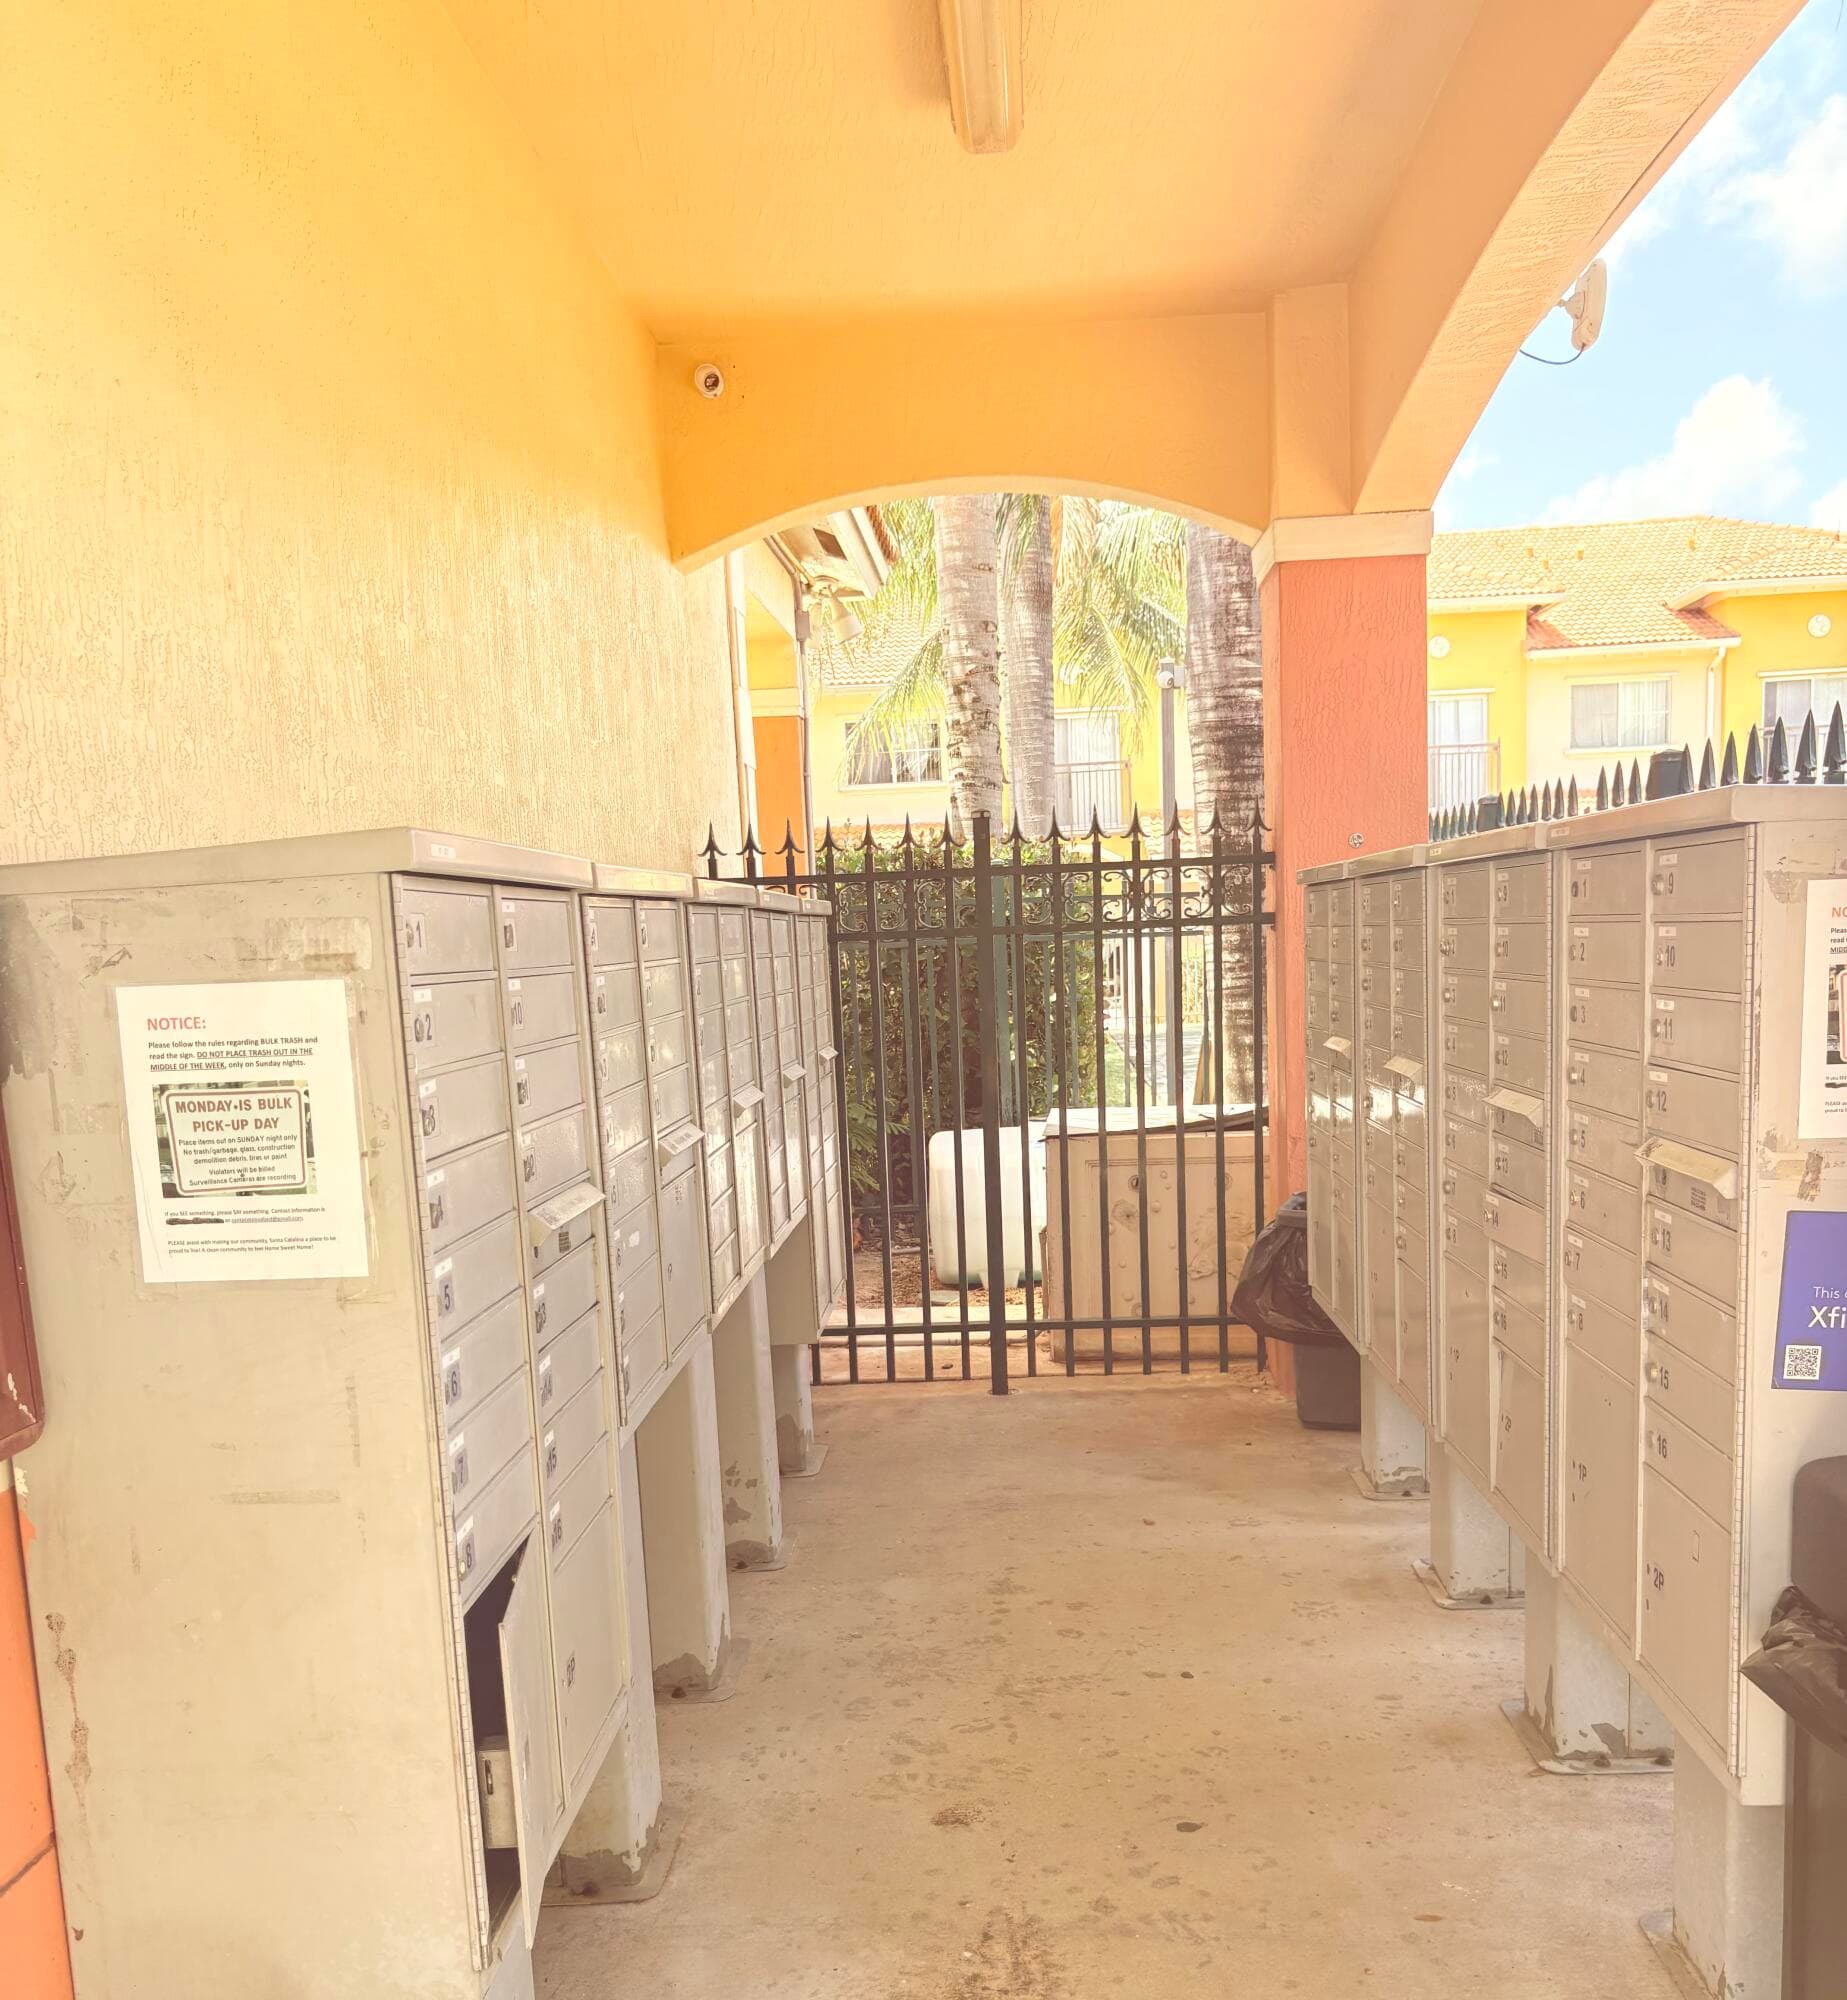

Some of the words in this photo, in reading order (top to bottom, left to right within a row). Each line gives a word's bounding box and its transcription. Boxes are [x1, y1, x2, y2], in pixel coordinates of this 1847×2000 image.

[1582, 879, 1587, 898] 1
[1668, 872, 1674, 894] 9
[416, 920, 422, 949] 1
[1580, 942, 1586, 962] 2
[1666, 945, 1676, 968] 10
[147, 1016, 206, 1031] NOTICE:
[514, 1002, 522, 1025] 10
[1580, 1005, 1586, 1024] 3
[426, 1014, 432, 1041] 2
[1664, 1017, 1673, 1040] 11
[148, 1041, 170, 1049] Please
[172, 1040, 193, 1048] follow
[226, 1038, 259, 1047] regarding
[180, 1052, 196, 1060] sign.
[300, 1048, 313, 1056] THE
[150, 1063, 177, 1071] MIDDLE
[204, 1062, 226, 1070] WEEK,
[228, 1061, 244, 1070] only
[256, 1060, 281, 1068] Sunday
[282, 1059, 306, 1068] nights.
[1580, 1069, 1586, 1086] 4
[175, 1100, 232, 1113] MONDAY
[239, 1099, 252, 1112] IS
[258, 1097, 292, 1110] BULK
[1656, 1090, 1667, 1112] 12
[192, 1119, 249, 1132] PICK-UP
[254, 1118, 280, 1130] DAY
[1580, 1130, 1586, 1148] 5
[272, 1153, 288, 1161] paint
[1580, 1191, 1586, 1209] 6
[1492, 1208, 1498, 1227] 14
[1662, 1228, 1671, 1252] 13
[1575, 1252, 1580, 1270] 7
[444, 1284, 450, 1310] 5
[1813, 1286, 1840, 1299] This
[1660, 1298, 1668, 1322] 14
[1808, 1305, 1847, 1329] Xfi
[1578, 1312, 1584, 1330] 8
[452, 1370, 458, 1397] 6
[1660, 1366, 1669, 1390] 15
[1656, 1434, 1668, 1458] 16
[458, 1456, 464, 1484] 7
[1578, 1462, 1587, 1482] 1P
[466, 1542, 472, 1569] 8
[1654, 1567, 1664, 1591] 2P
